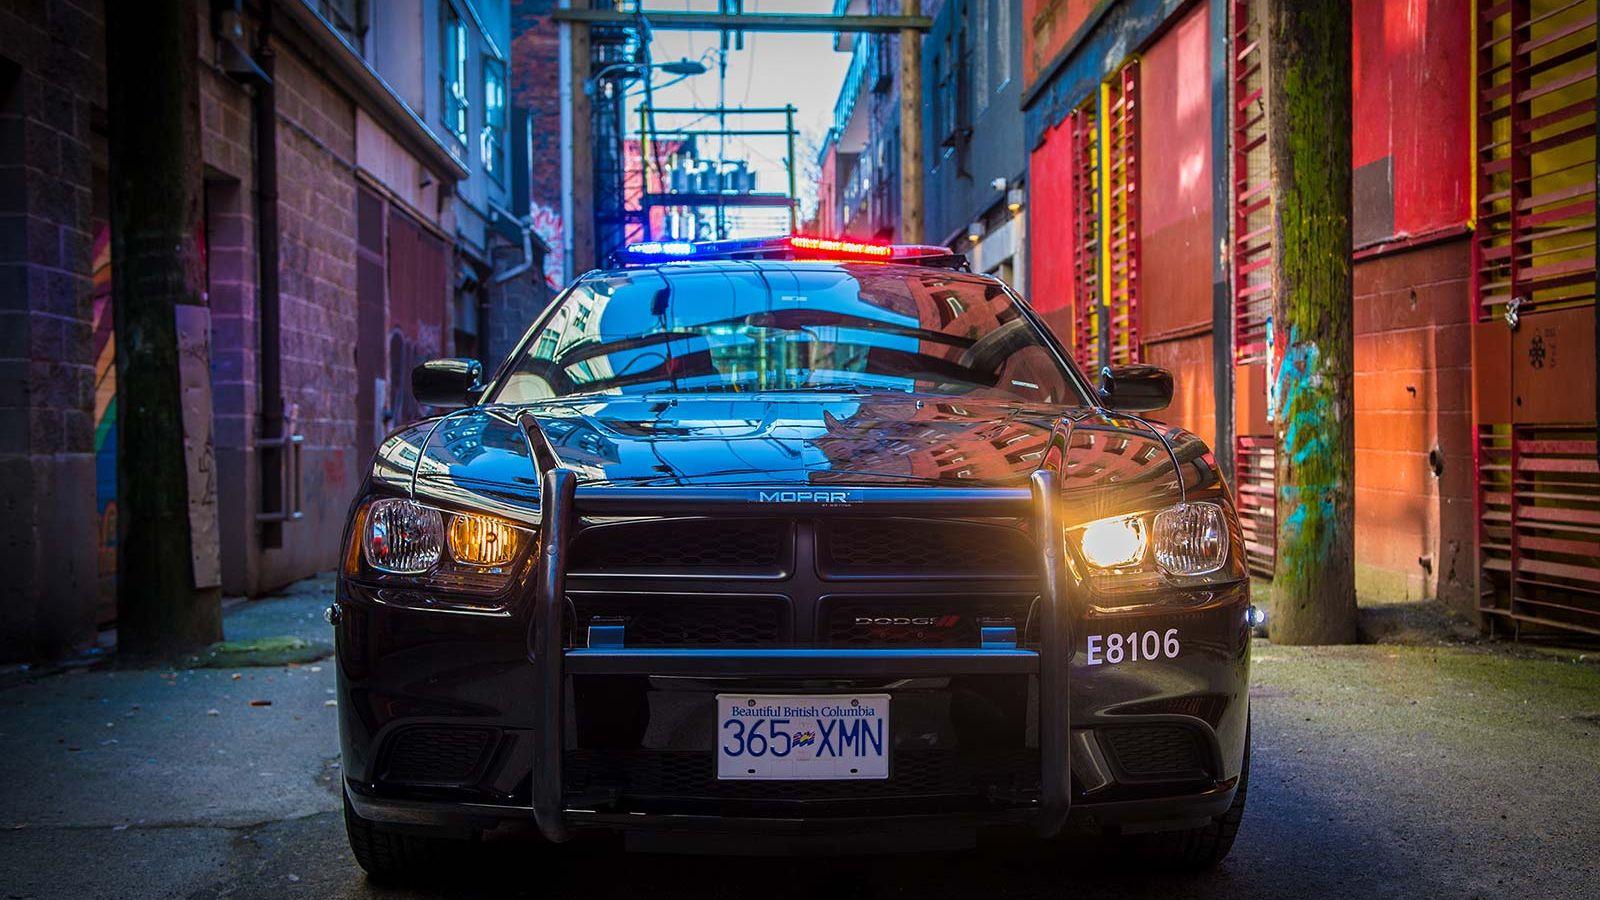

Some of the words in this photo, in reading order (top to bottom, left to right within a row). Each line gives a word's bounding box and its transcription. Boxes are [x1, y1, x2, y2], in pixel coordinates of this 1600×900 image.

[759, 491, 847, 503] MOPAR
[1087, 628, 1180, 666] E8106
[732, 706, 780, 717] Beautiful
[784, 706, 819, 717] British
[821, 706, 875, 717] Columbia
[723, 719, 791, 757] 365
[816, 719, 882, 757] XMN
